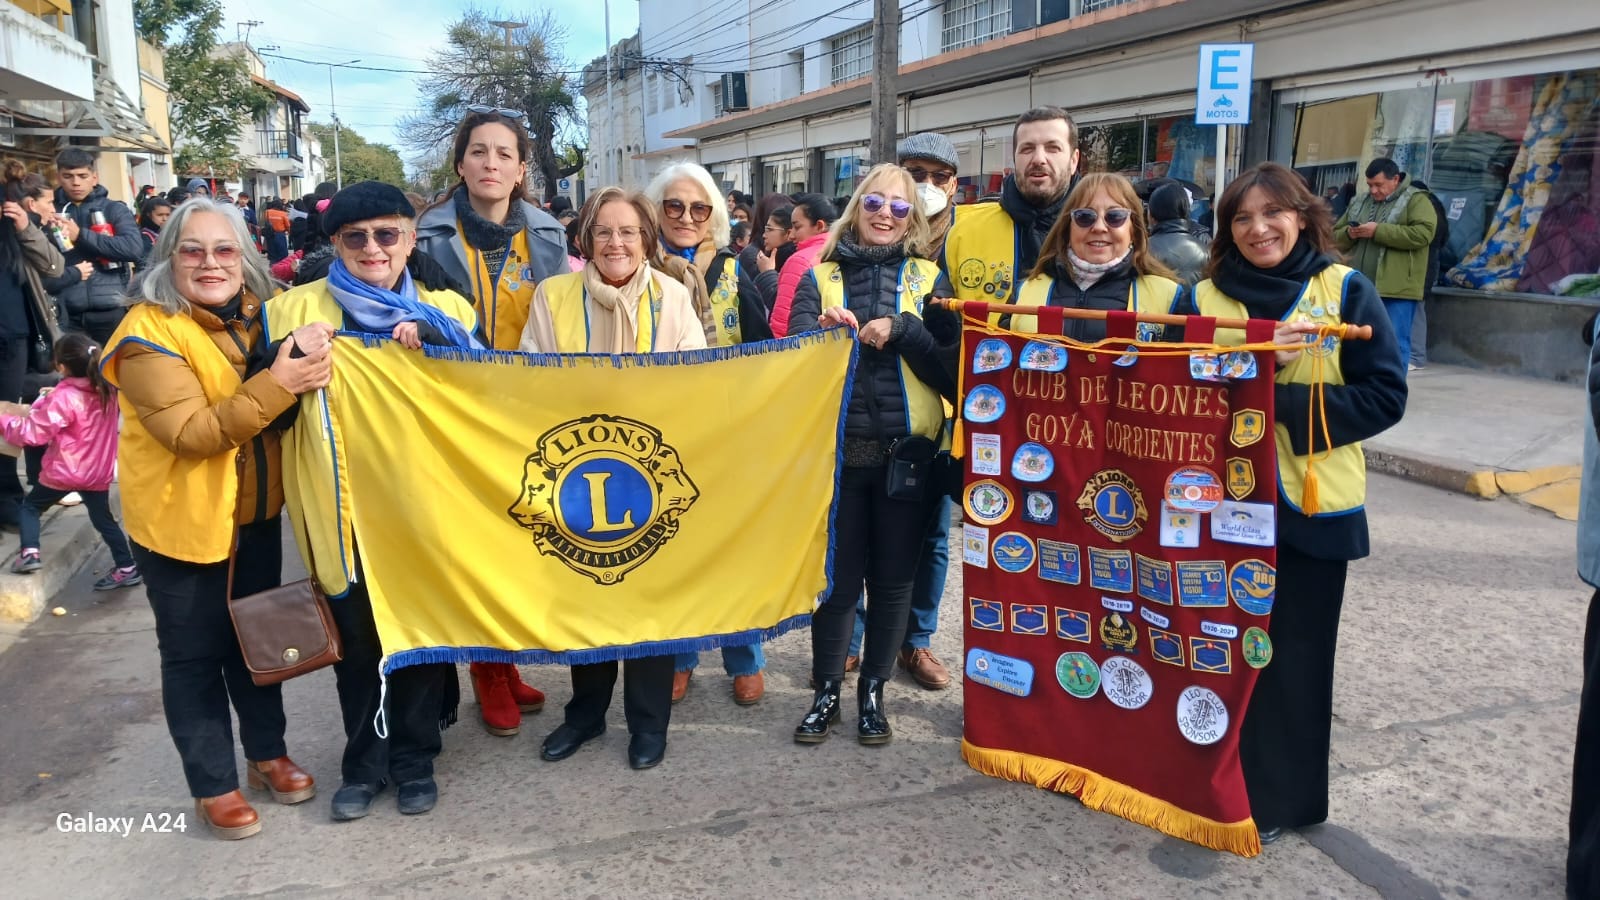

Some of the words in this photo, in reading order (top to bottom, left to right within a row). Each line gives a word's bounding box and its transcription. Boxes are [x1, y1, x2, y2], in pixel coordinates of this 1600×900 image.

[1210, 50, 1240, 89] E
[1206, 110, 1239, 118] MOTOS
[1013, 368, 1067, 401] CLUB
[1080, 375, 1110, 405] DE
[1117, 378, 1230, 421] LEONES
[551, 425, 650, 456] LIONS
[1026, 412, 1095, 450] GOYA
[1106, 419, 1216, 464] CORRIENTES
[1097, 472, 1135, 490] LIONS
[582, 472, 636, 533] L
[1106, 490, 1128, 520] L
[1220, 523, 1241, 532] World
[549, 525, 665, 567] INTERNATIONAL
[1204, 570, 1222, 583] 100
[1253, 571, 1276, 586] ORO
[1203, 624, 1235, 636] 2020-2021
[1103, 660, 1118, 674] LEO
[1121, 659, 1145, 677] CLUB
[1107, 688, 1148, 707] SPONSOR
[1184, 688, 1201, 703] LEO
[1206, 691, 1226, 716] CLUB
[1179, 716, 1218, 742] SPONSOR
